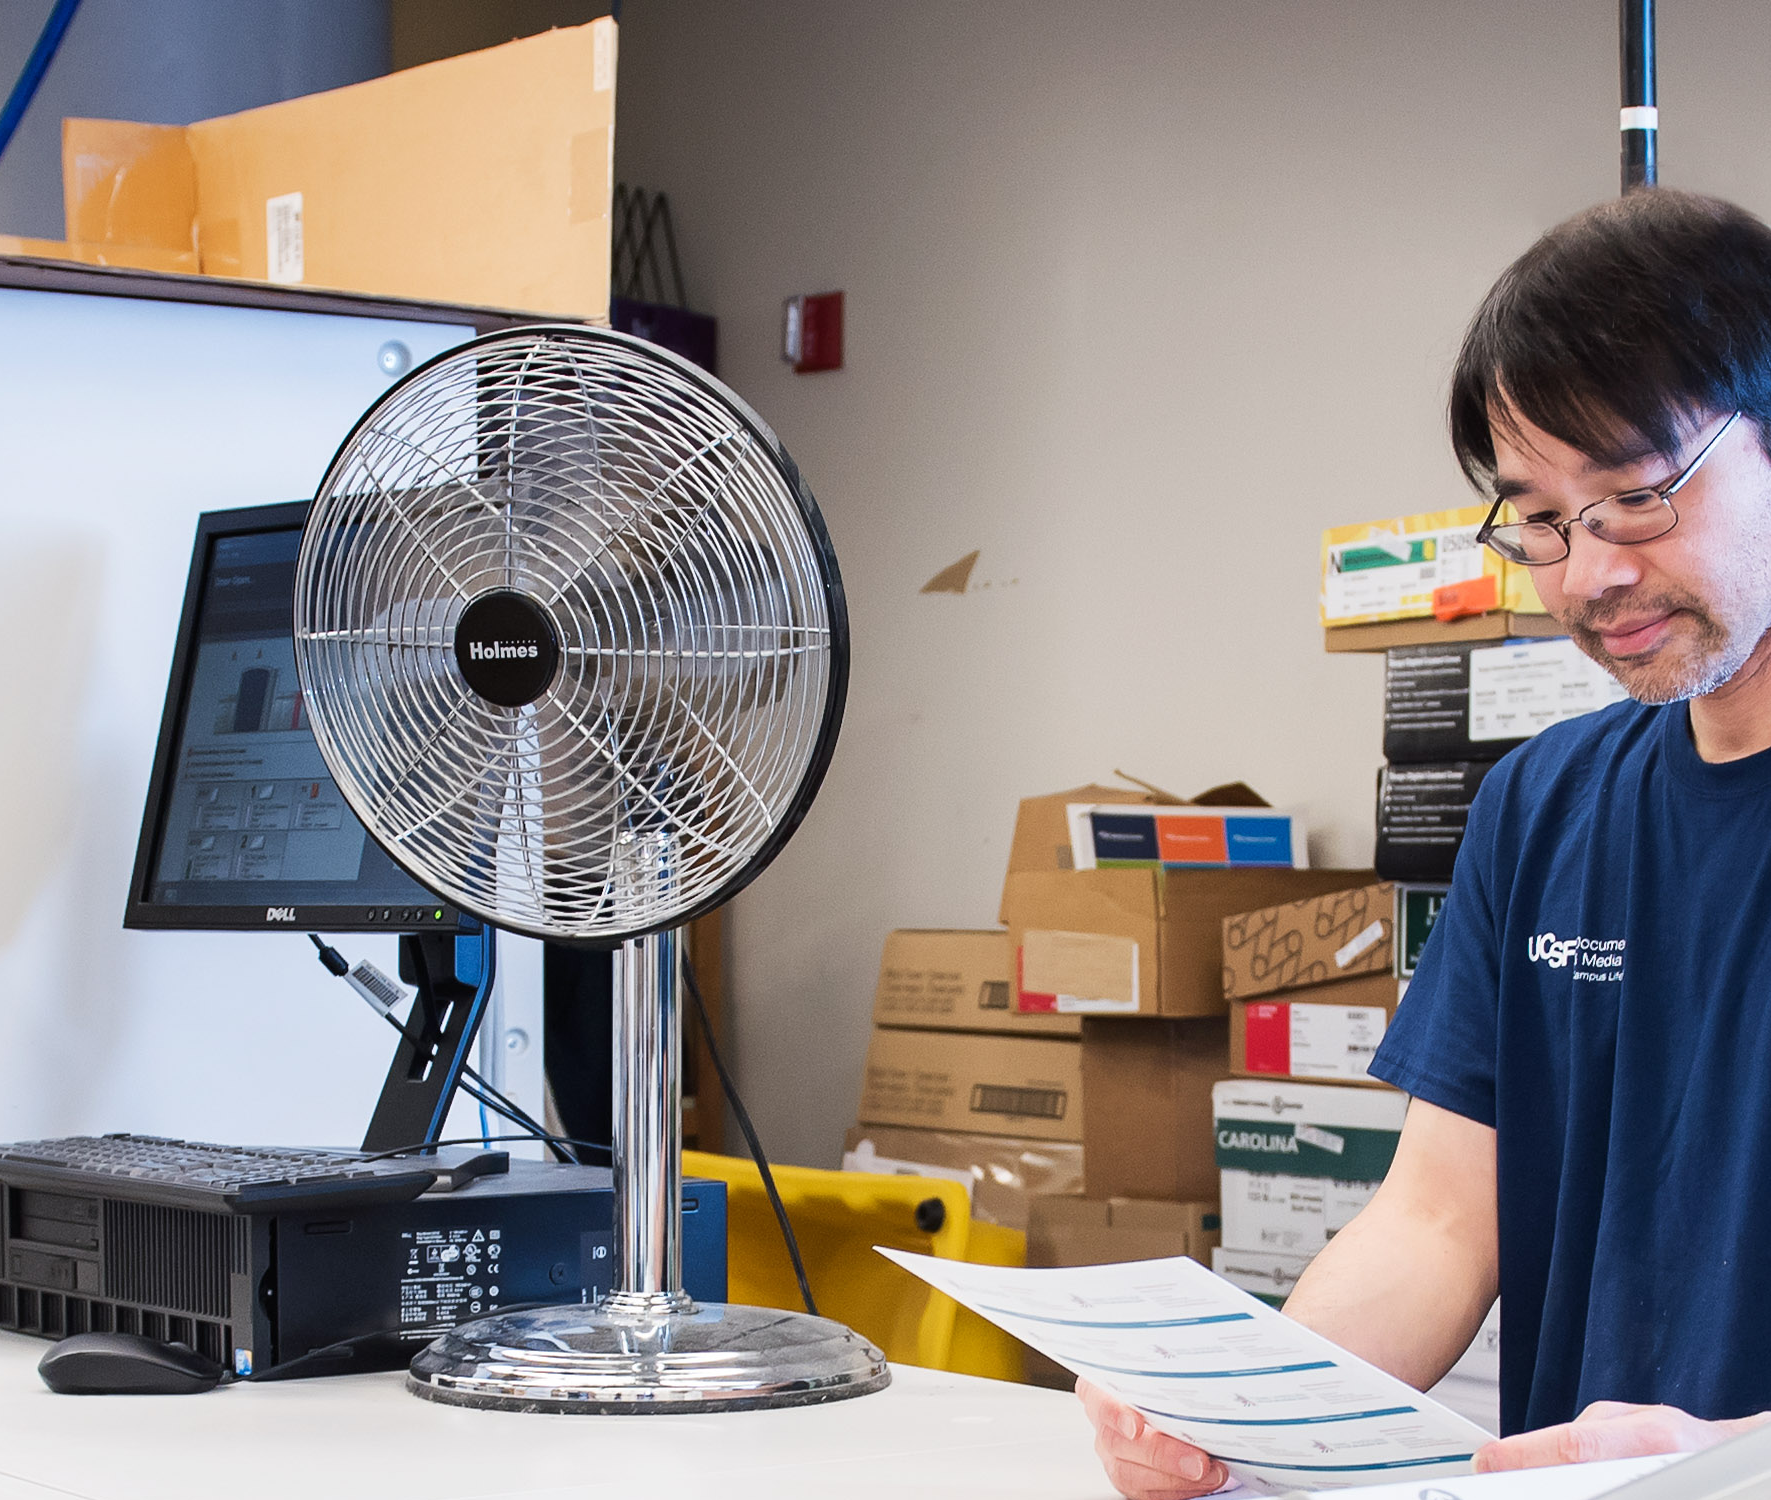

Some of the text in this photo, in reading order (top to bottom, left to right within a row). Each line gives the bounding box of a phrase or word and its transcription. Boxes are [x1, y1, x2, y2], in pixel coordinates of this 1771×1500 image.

[470, 641, 538, 660] Holmes
[266, 907, 296, 922] DELL
[1528, 932, 1578, 969] UCSF
[1582, 953, 1622, 968] Media
[1573, 970, 1607, 982] ampus
[1217, 1130, 1299, 1154] CAROLINA
